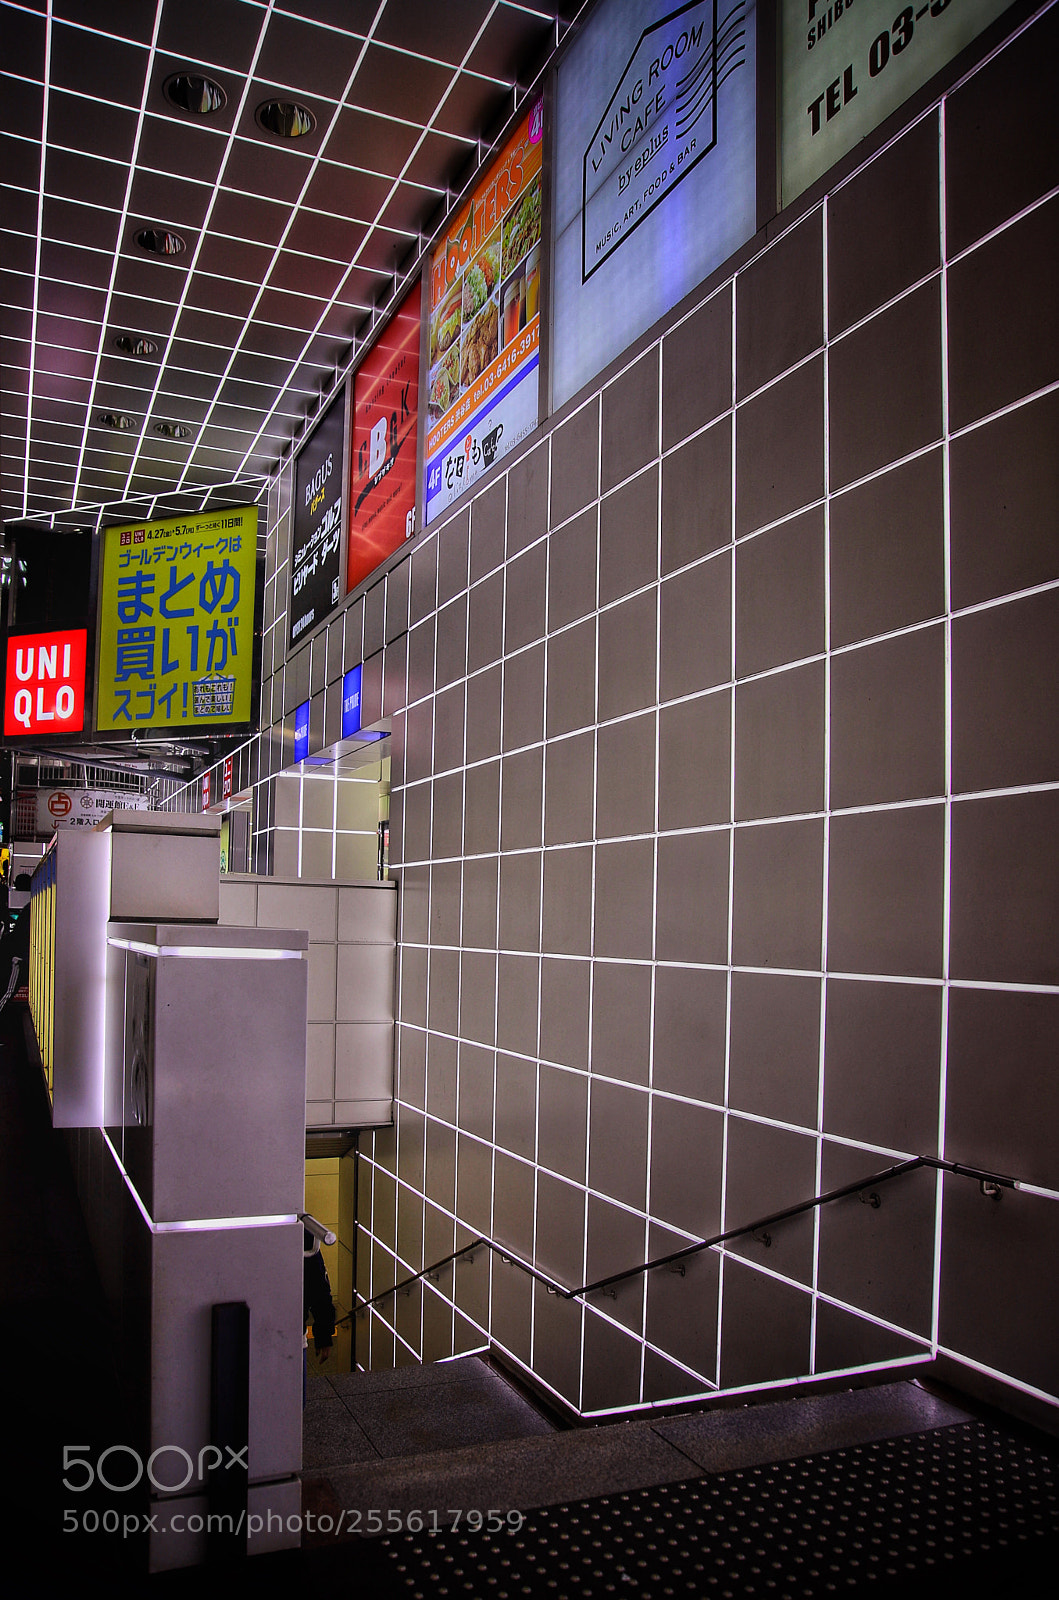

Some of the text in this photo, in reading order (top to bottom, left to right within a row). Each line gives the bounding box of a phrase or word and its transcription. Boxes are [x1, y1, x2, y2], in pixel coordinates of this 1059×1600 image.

[591, 21, 705, 173] LIVING ROOM
[620, 84, 666, 153] CAFE
[807, 63, 858, 137] TEL
[618, 125, 670, 193] by eplus
[595, 138, 698, 254] MUSIC, ART, FOOD & BAR
[431, 146, 525, 309] HOOTERS
[428, 414, 455, 451] HOOTERS
[304, 453, 333, 507] BAGUS
[428, 466, 441, 490] 4F
[119, 535, 242, 568] ゴールデンウィークは
[321, 527, 341, 566] ダーツ
[117, 559, 241, 624] まとめ
[15, 643, 71, 682] UNI
[114, 617, 239, 682] 買いが
[14, 686, 75, 728] QLO
[112, 682, 189, 722] スゴイ!
[70, 817, 100, 826] 2階入口
